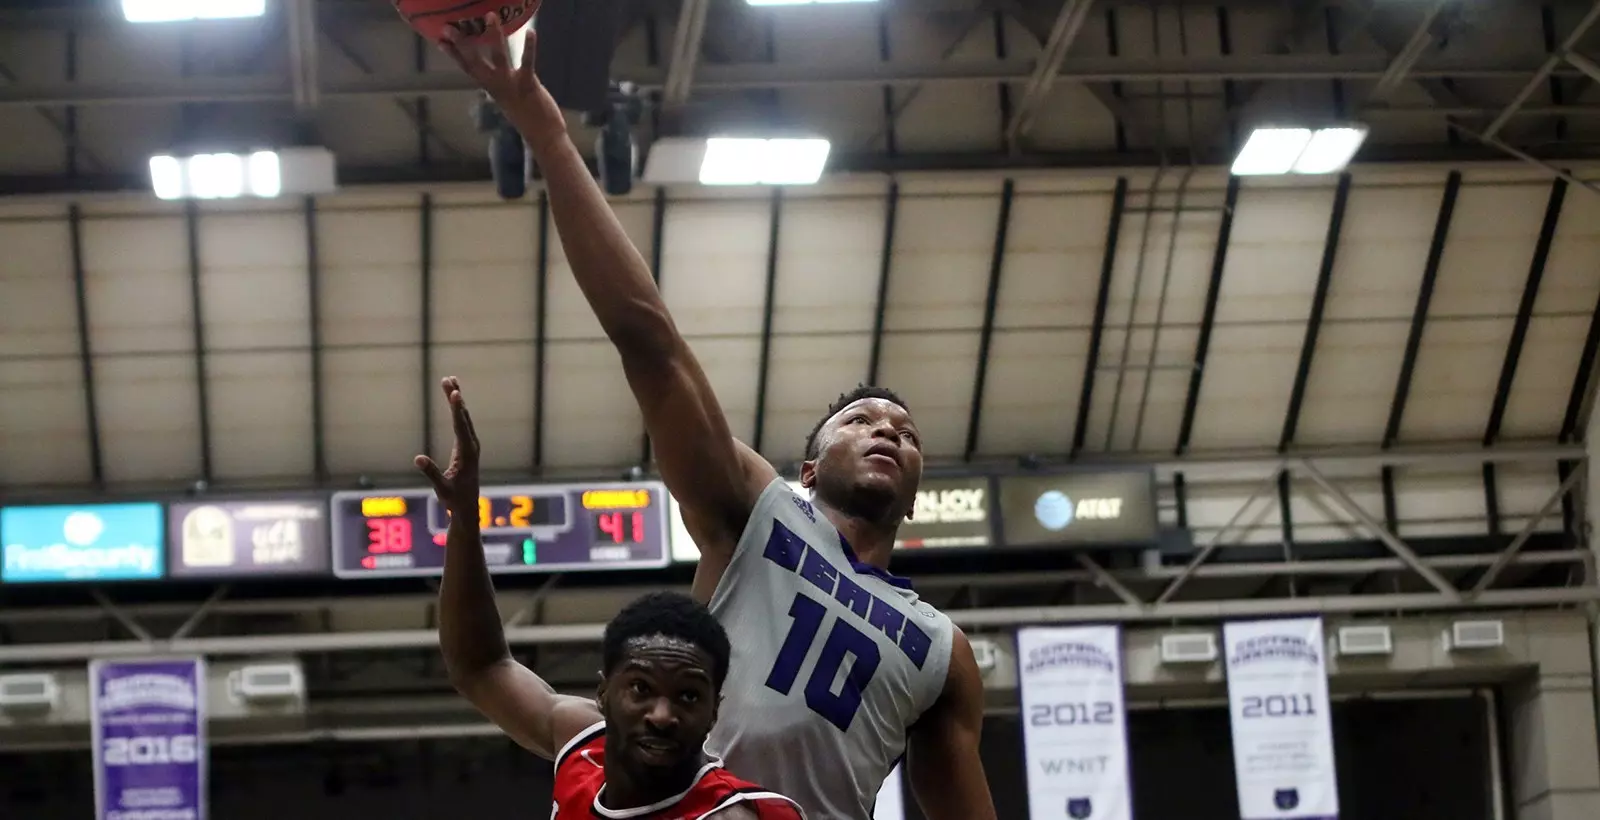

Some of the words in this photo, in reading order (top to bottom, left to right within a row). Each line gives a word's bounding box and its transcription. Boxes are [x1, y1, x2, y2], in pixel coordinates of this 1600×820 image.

[1076, 498, 1122, 519] AT&T
[366, 517, 412, 553] 38
[599, 511, 645, 544] 41
[765, 592, 881, 733] 10
[1030, 701, 1114, 727] 2012
[1241, 693, 1316, 719] 2011
[103, 735, 196, 765] 2016
[1040, 754, 1110, 776] WNIT
